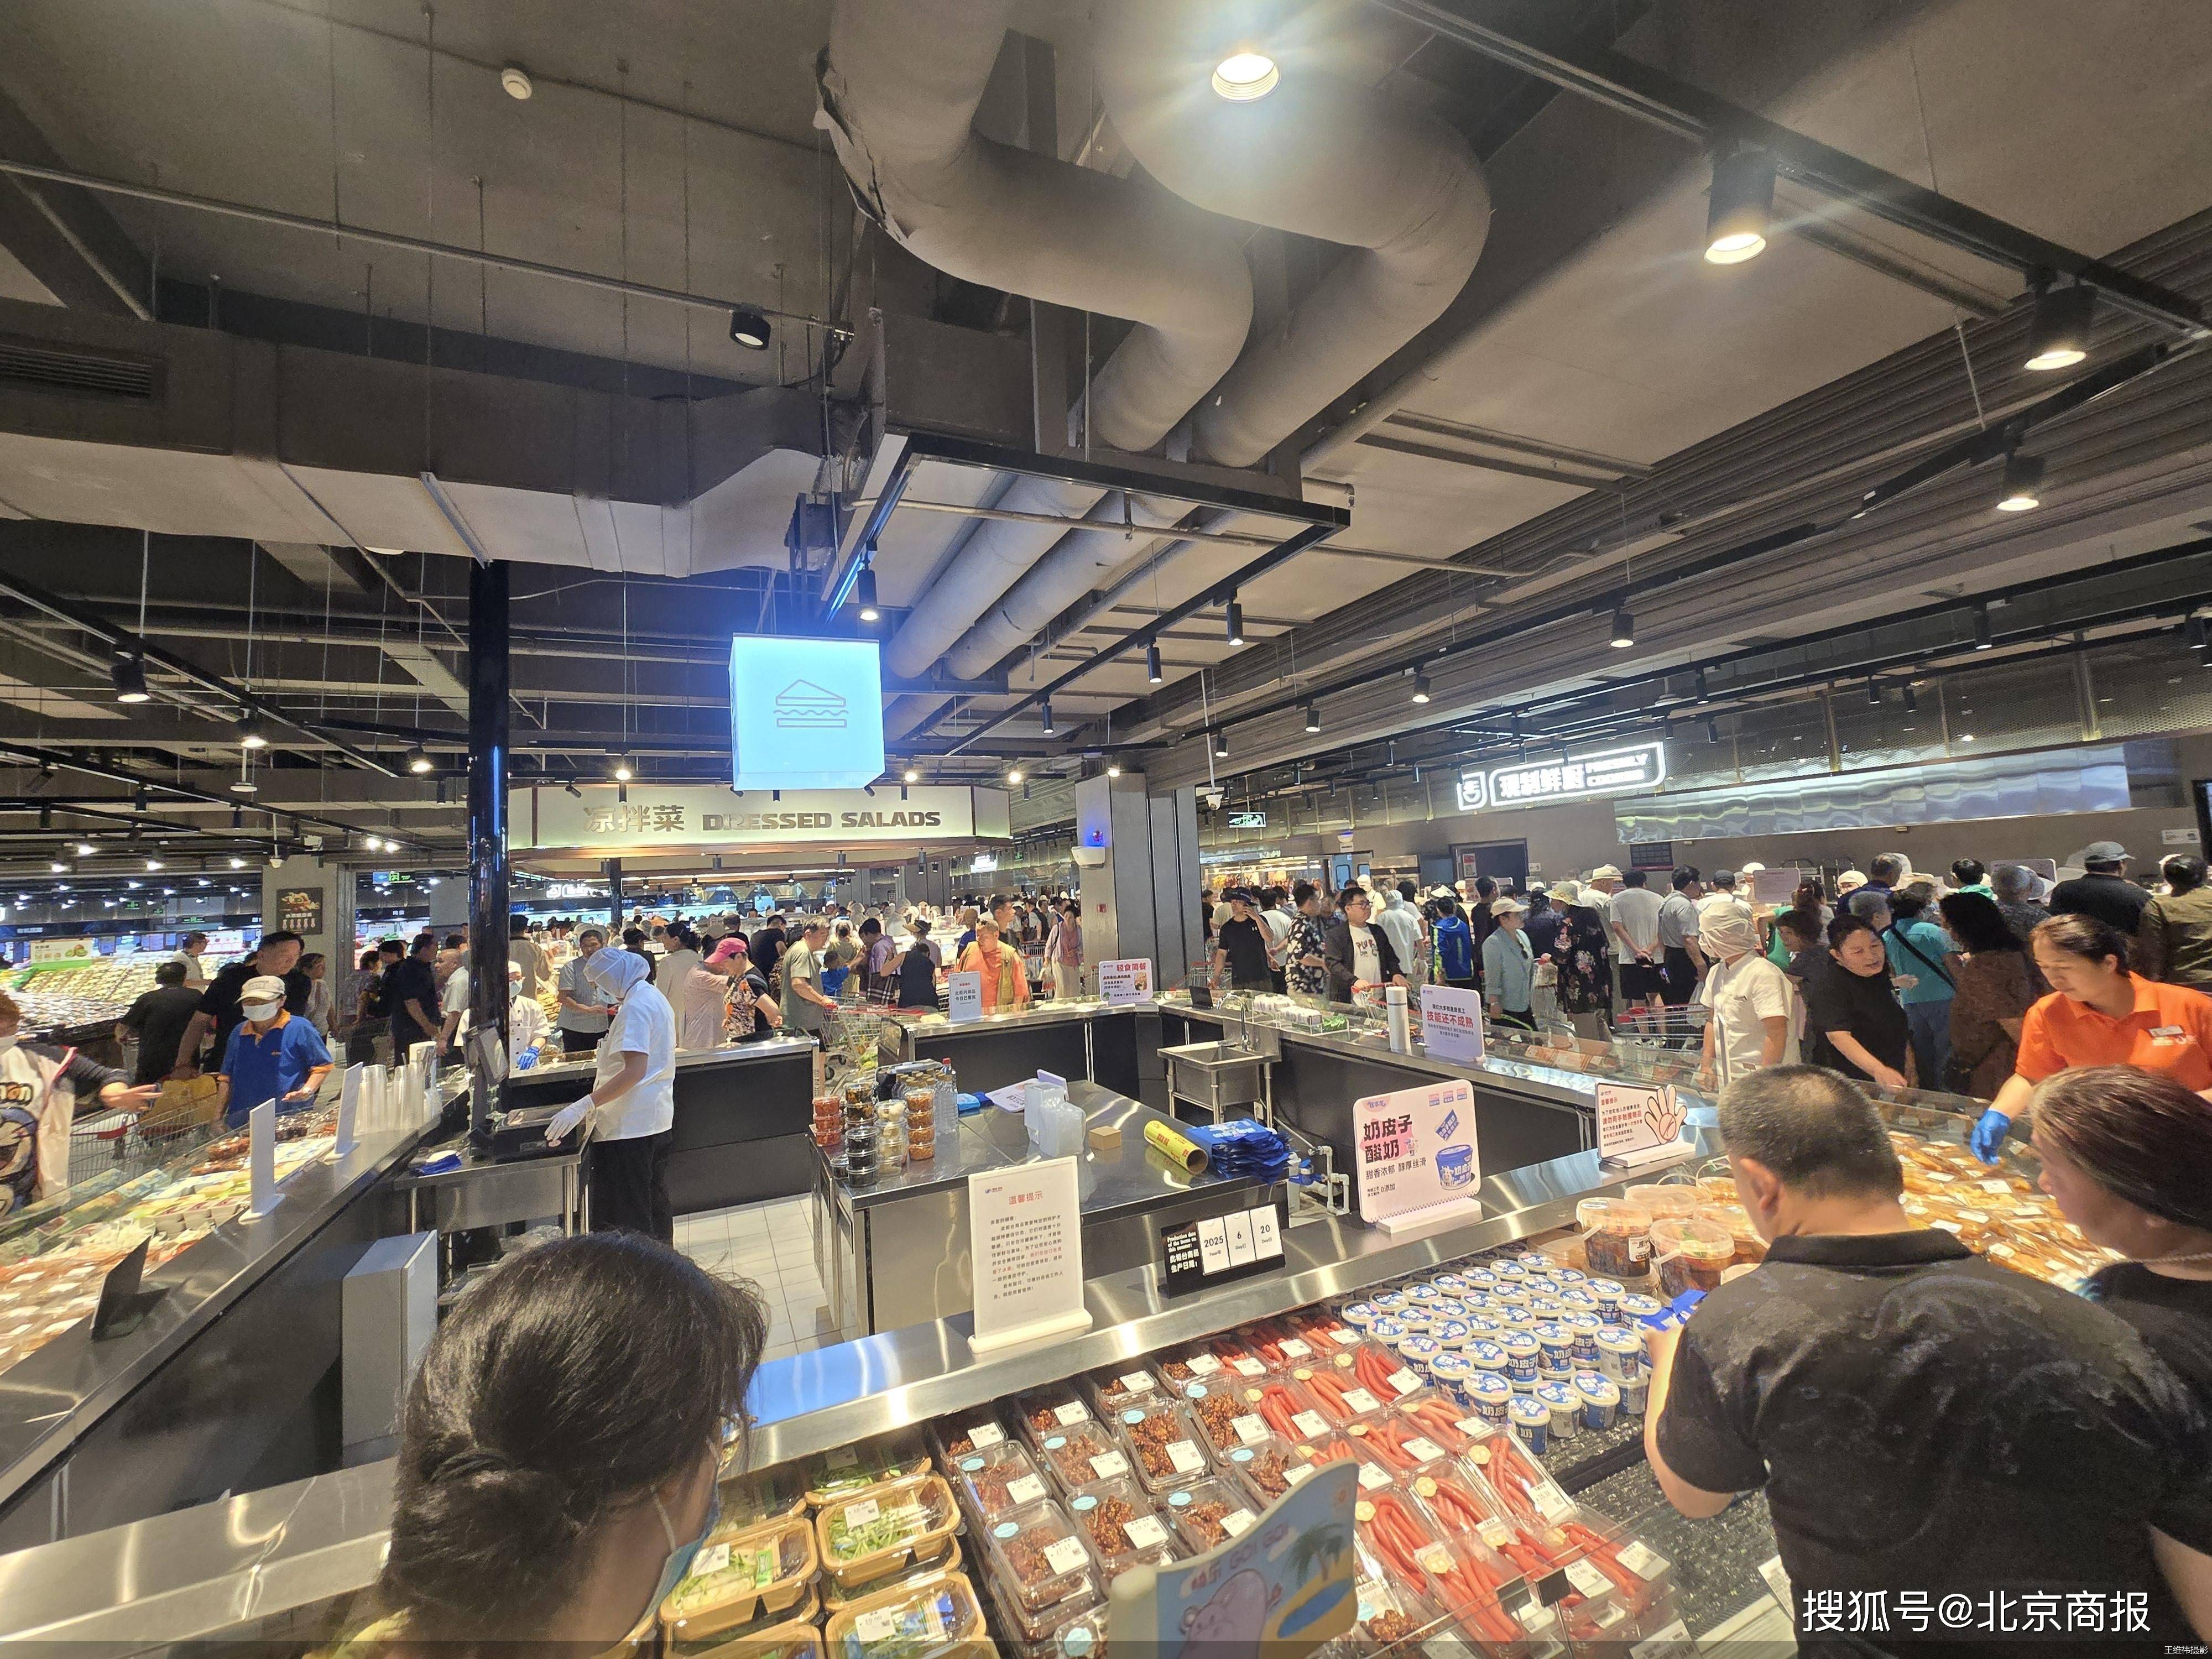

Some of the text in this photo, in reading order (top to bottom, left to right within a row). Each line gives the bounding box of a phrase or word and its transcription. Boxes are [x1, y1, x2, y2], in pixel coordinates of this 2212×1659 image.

[1499, 764, 1585, 798] 现制鲜厨
[583, 804, 685, 834] 凉拌菜
[702, 811, 942, 832] DRESSED SALADS
[1116, 963, 1146, 972] 轻食简餐
[1426, 1010, 1474, 1029] 技能还不成熟
[1363, 1114, 1412, 1142] 奶皮子
[1365, 1139, 1400, 1164] 酸奶
[1365, 1157, 1427, 1180] 甜香浓郁 醇厚丝滑
[1008, 1191, 1043, 1205] 温馨提示
[1237, 1231, 1242, 1239] 6
[1260, 1224, 1270, 1234] 20
[1204, 1235, 1224, 1248] 2025
[1170, 1249, 1199, 1264] 此柜台商品
